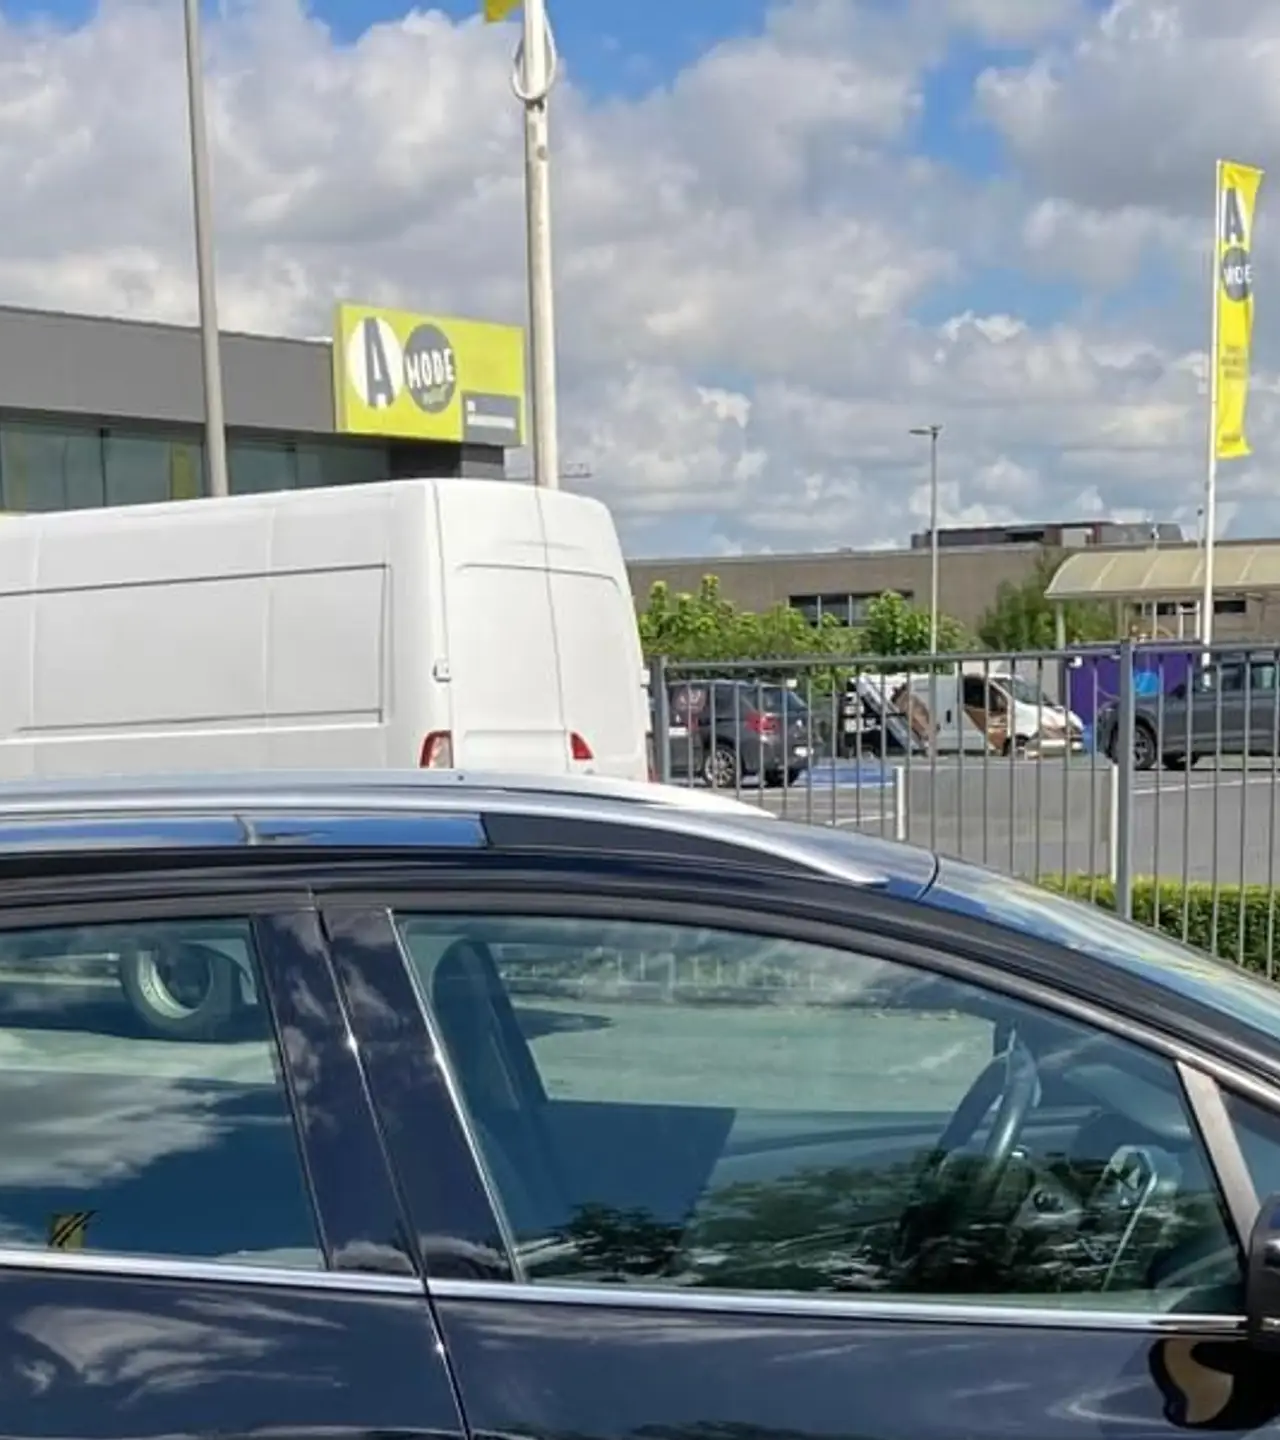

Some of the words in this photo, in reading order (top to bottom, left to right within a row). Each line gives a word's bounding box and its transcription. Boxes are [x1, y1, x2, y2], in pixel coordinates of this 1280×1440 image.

[1225, 187, 1244, 243] A
[363, 317, 396, 409] A
[405, 347, 455, 389] MODE
